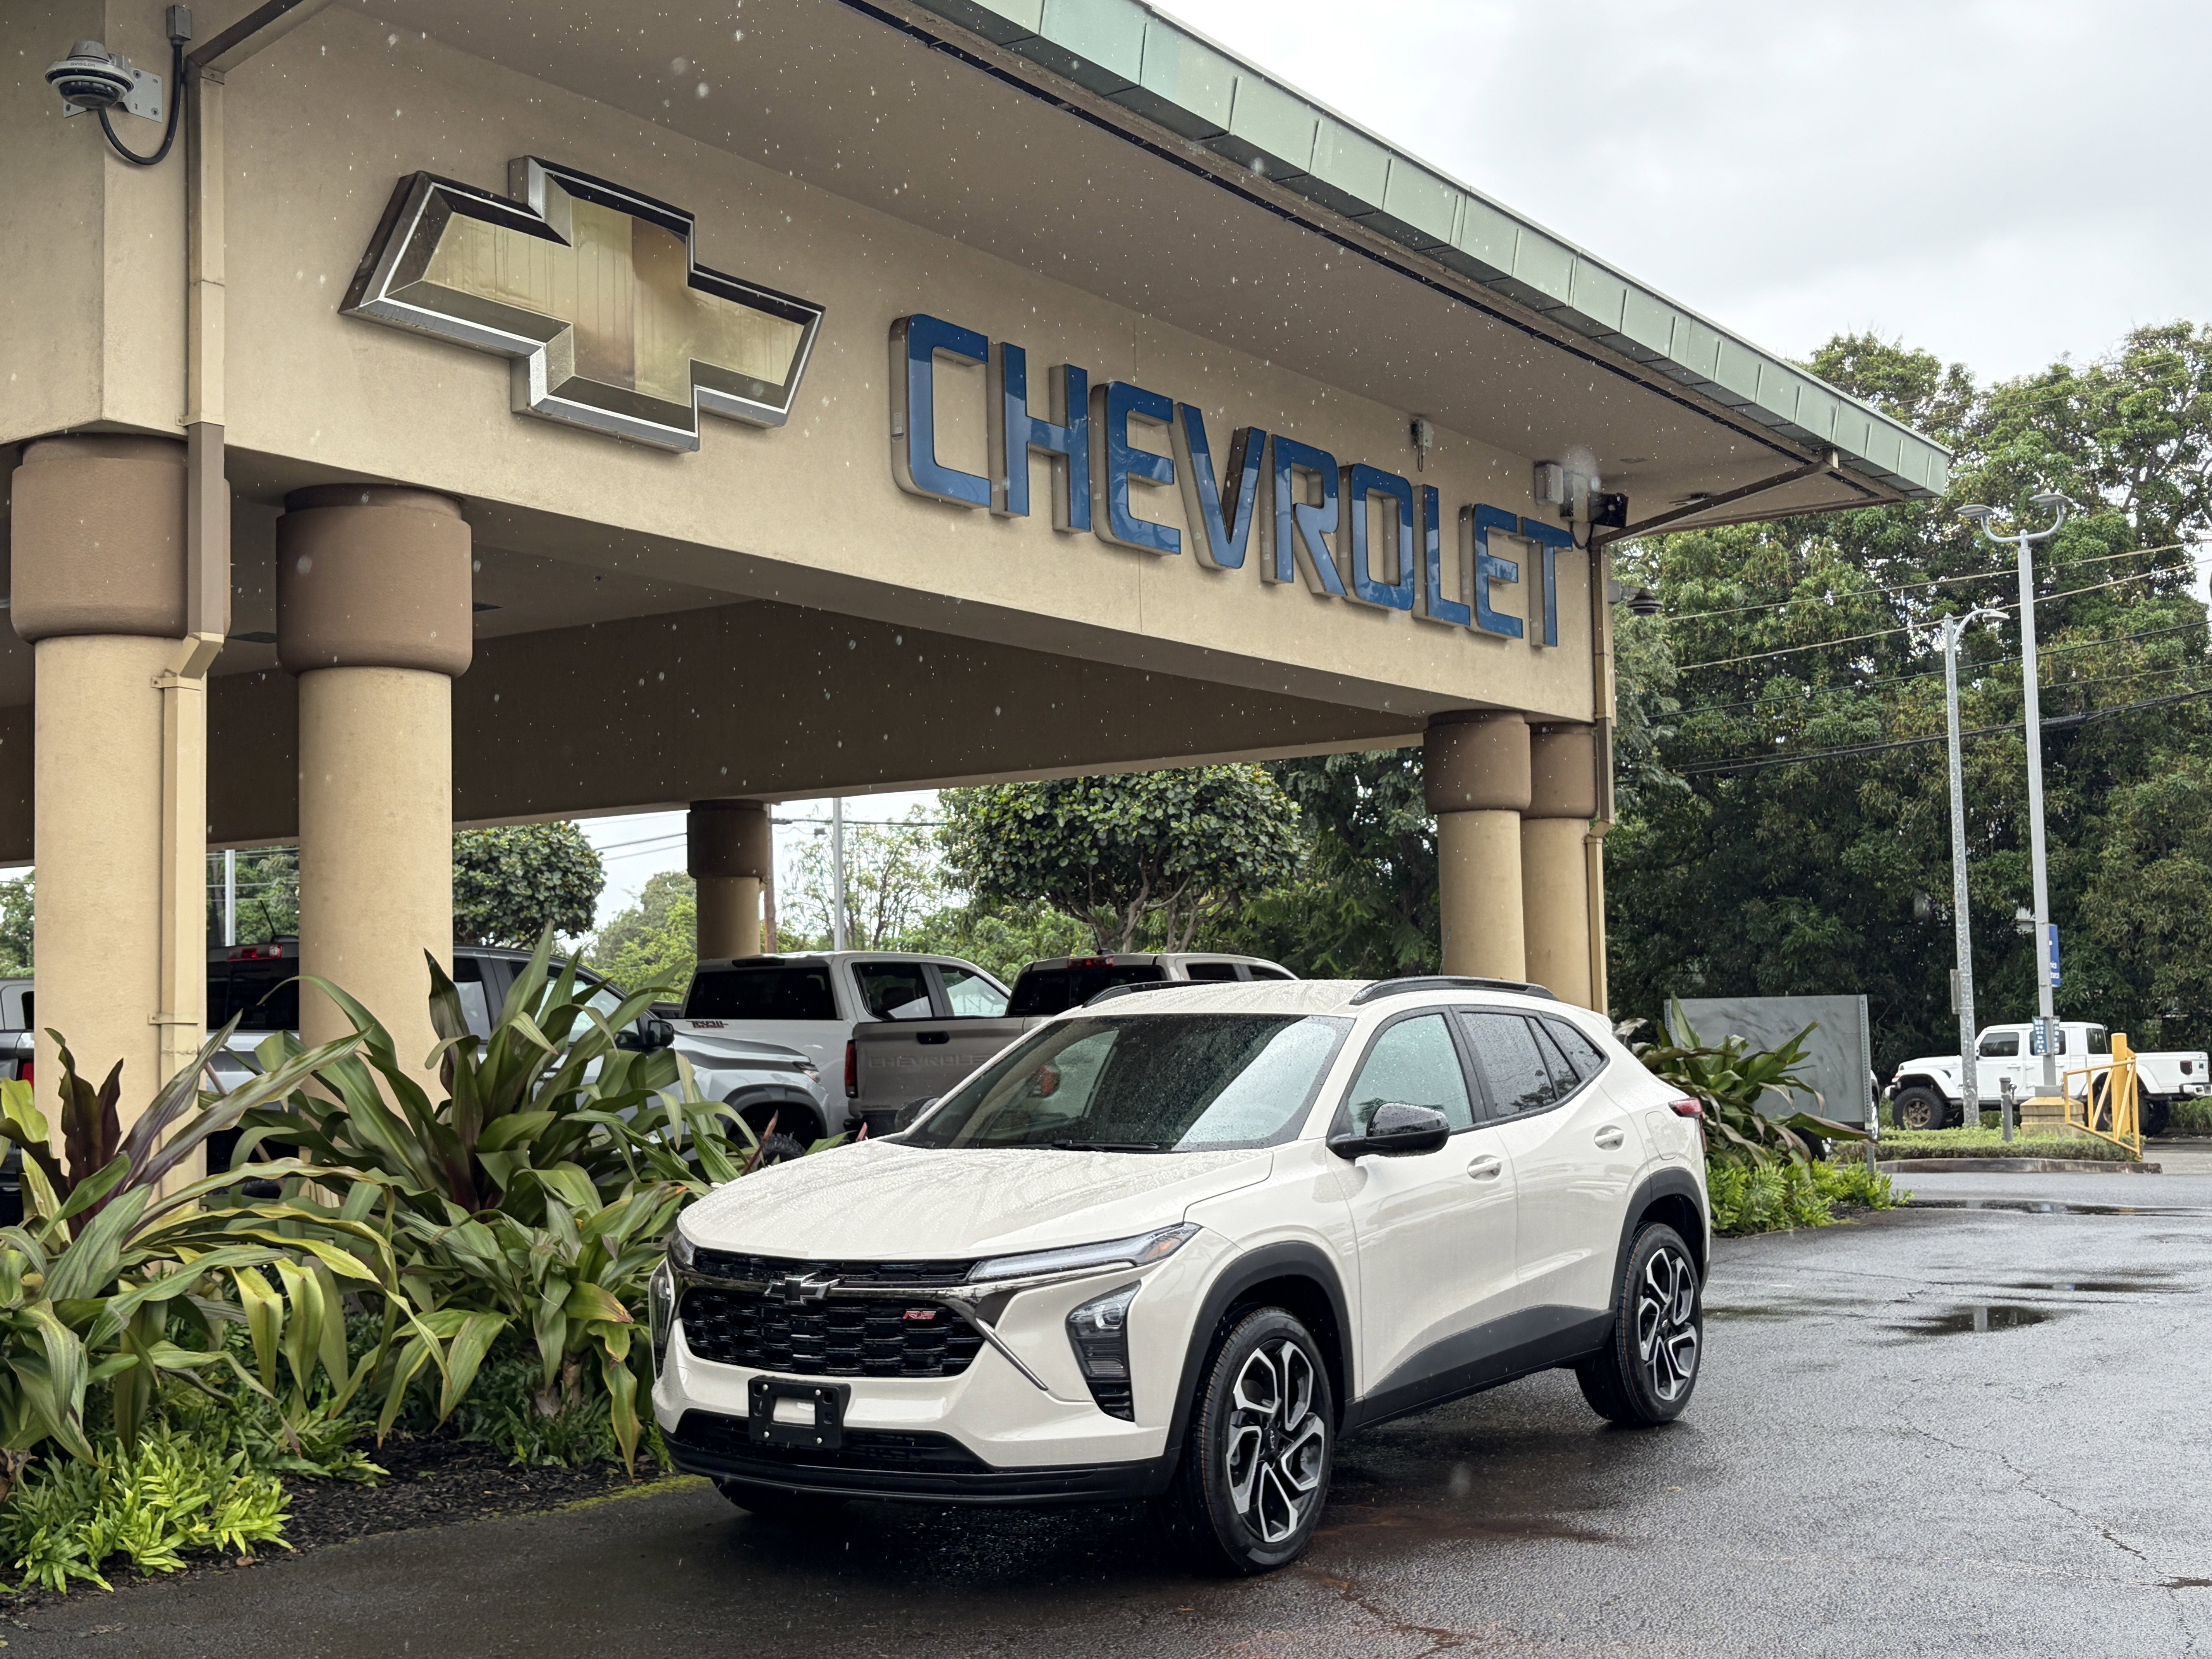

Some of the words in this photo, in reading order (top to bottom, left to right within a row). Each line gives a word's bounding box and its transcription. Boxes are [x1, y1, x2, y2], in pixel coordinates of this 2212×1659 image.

[890, 313, 1572, 647] CHEVROLET
[869, 1053, 992, 1068] CHEVROLE
[903, 1310, 936, 1319] RS
